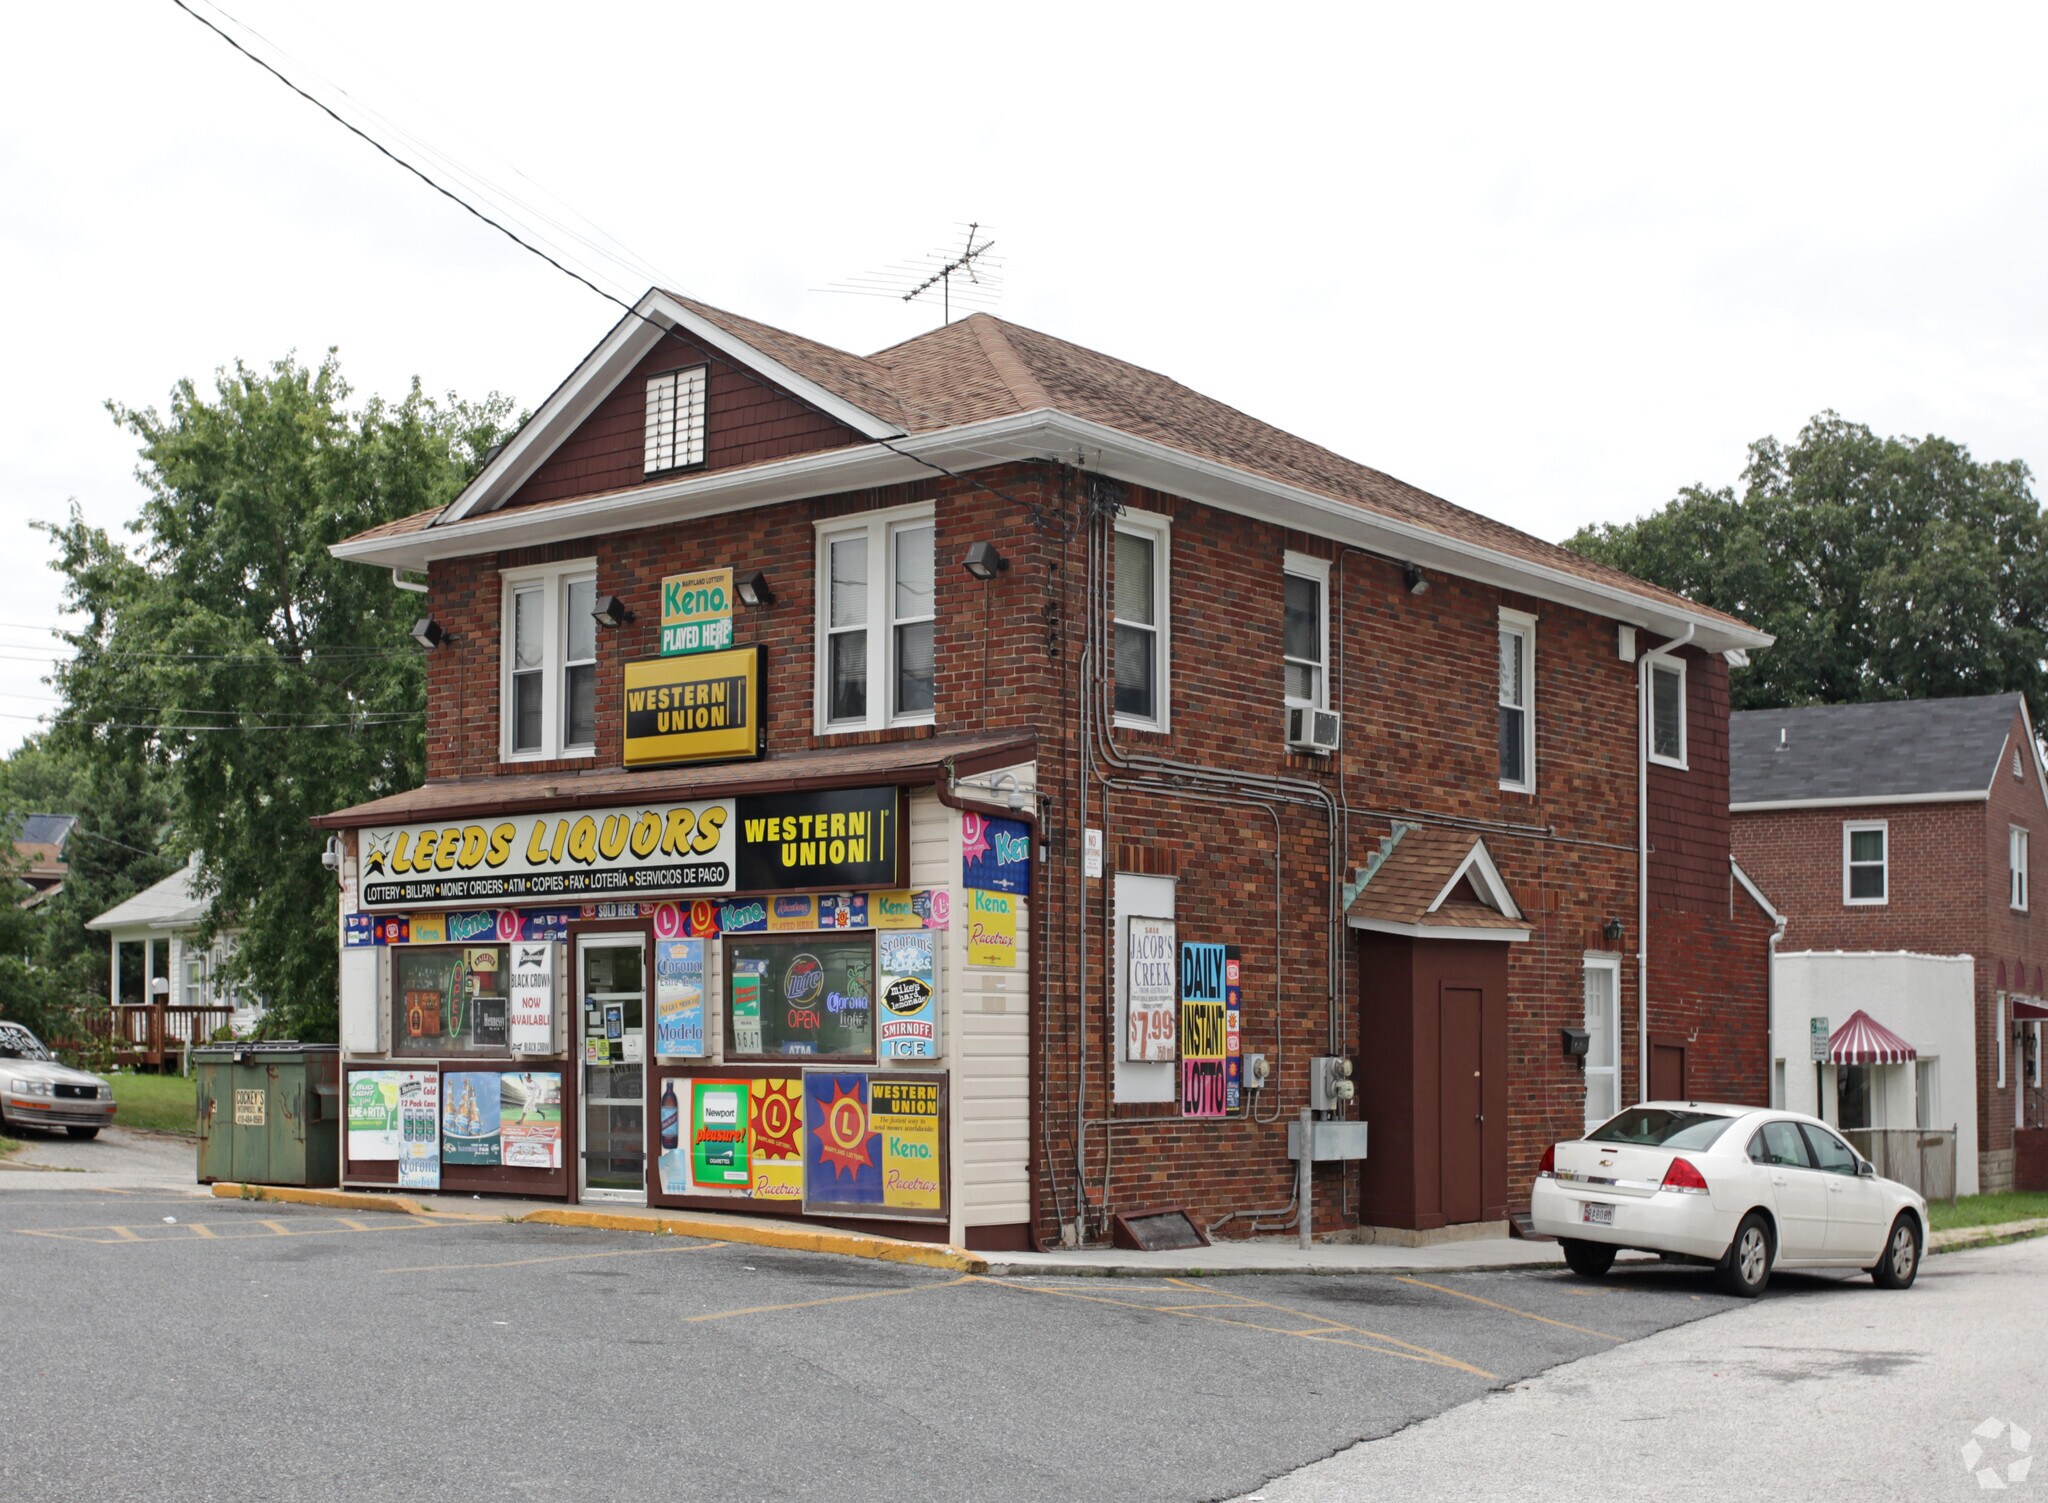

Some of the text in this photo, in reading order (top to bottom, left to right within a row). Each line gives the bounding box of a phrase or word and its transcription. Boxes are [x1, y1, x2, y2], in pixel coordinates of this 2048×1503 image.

[706, 575, 725, 585] LOTTERY
[663, 621, 730, 652] PLAYED HERE
[628, 682, 725, 712] WESTERN
[657, 705, 725, 733] UNION
[744, 811, 865, 843] WESTERN
[966, 816, 974, 834] L
[391, 806, 728, 875] LEEDS LIQUORS
[995, 830, 1030, 866] Ken
[1088, 835, 1097, 848] NO
[781, 838, 865, 867] UNION
[367, 886, 400, 901] LOTTERY
[406, 884, 436, 898] BILLPAY
[441, 882, 468, 896] MONEY
[470, 879, 503, 895] ORDERS
[508, 878, 526, 892] ATM
[531, 876, 564, 892] COPIES
[570, 874, 585, 889] FAX
[590, 870, 628, 888] LOTERÍA
[634, 869, 682, 886] SERVICIOS
[684, 867, 697, 883] DE
[698, 866, 725, 883] PAGO
[598, 905, 616, 918] SOLD
[618, 904, 636, 917] HERE
[970, 922, 1014, 947] Racetrax
[880, 934, 932, 957] Seagram's
[1130, 934, 1173, 960] JACOB'S
[657, 960, 702, 976] Corona
[1134, 960, 1171, 987] CREEK
[1184, 945, 1224, 998] DAILY
[512, 974, 529, 988] BLACK
[890, 982, 920, 996] mike's
[522, 998, 541, 1009] NOW
[826, 992, 869, 1014] Corona
[891, 996, 926, 1010] lemonade
[898, 992, 920, 1002] hard
[787, 1009, 820, 1030] OPEN
[658, 1023, 702, 1041] Modelo
[884, 1023, 932, 1038] SMIRNOFF
[1131, 1010, 1173, 1061] $7.99
[1184, 1004, 1224, 1057] INSTANT
[538, 1042, 550, 1051] CROW
[788, 1045, 812, 1054] ATM
[889, 1041, 926, 1056] ICE
[236, 1090, 264, 1105] COCKEY'S
[424, 1086, 436, 1096] Cold
[873, 1086, 937, 1100] WESTERN
[1184, 1060, 1224, 1114] LOTTO
[424, 1100, 436, 1108] Cans
[706, 1108, 734, 1118] Newport
[892, 1100, 936, 1114] UNION
[772, 1106, 780, 1127] L
[842, 1112, 852, 1136] L
[696, 1126, 746, 1145] pleasure!
[400, 1152, 438, 1175] Corona
[754, 1175, 800, 1198] Racetrax
[886, 1169, 937, 1192] Racetrax
